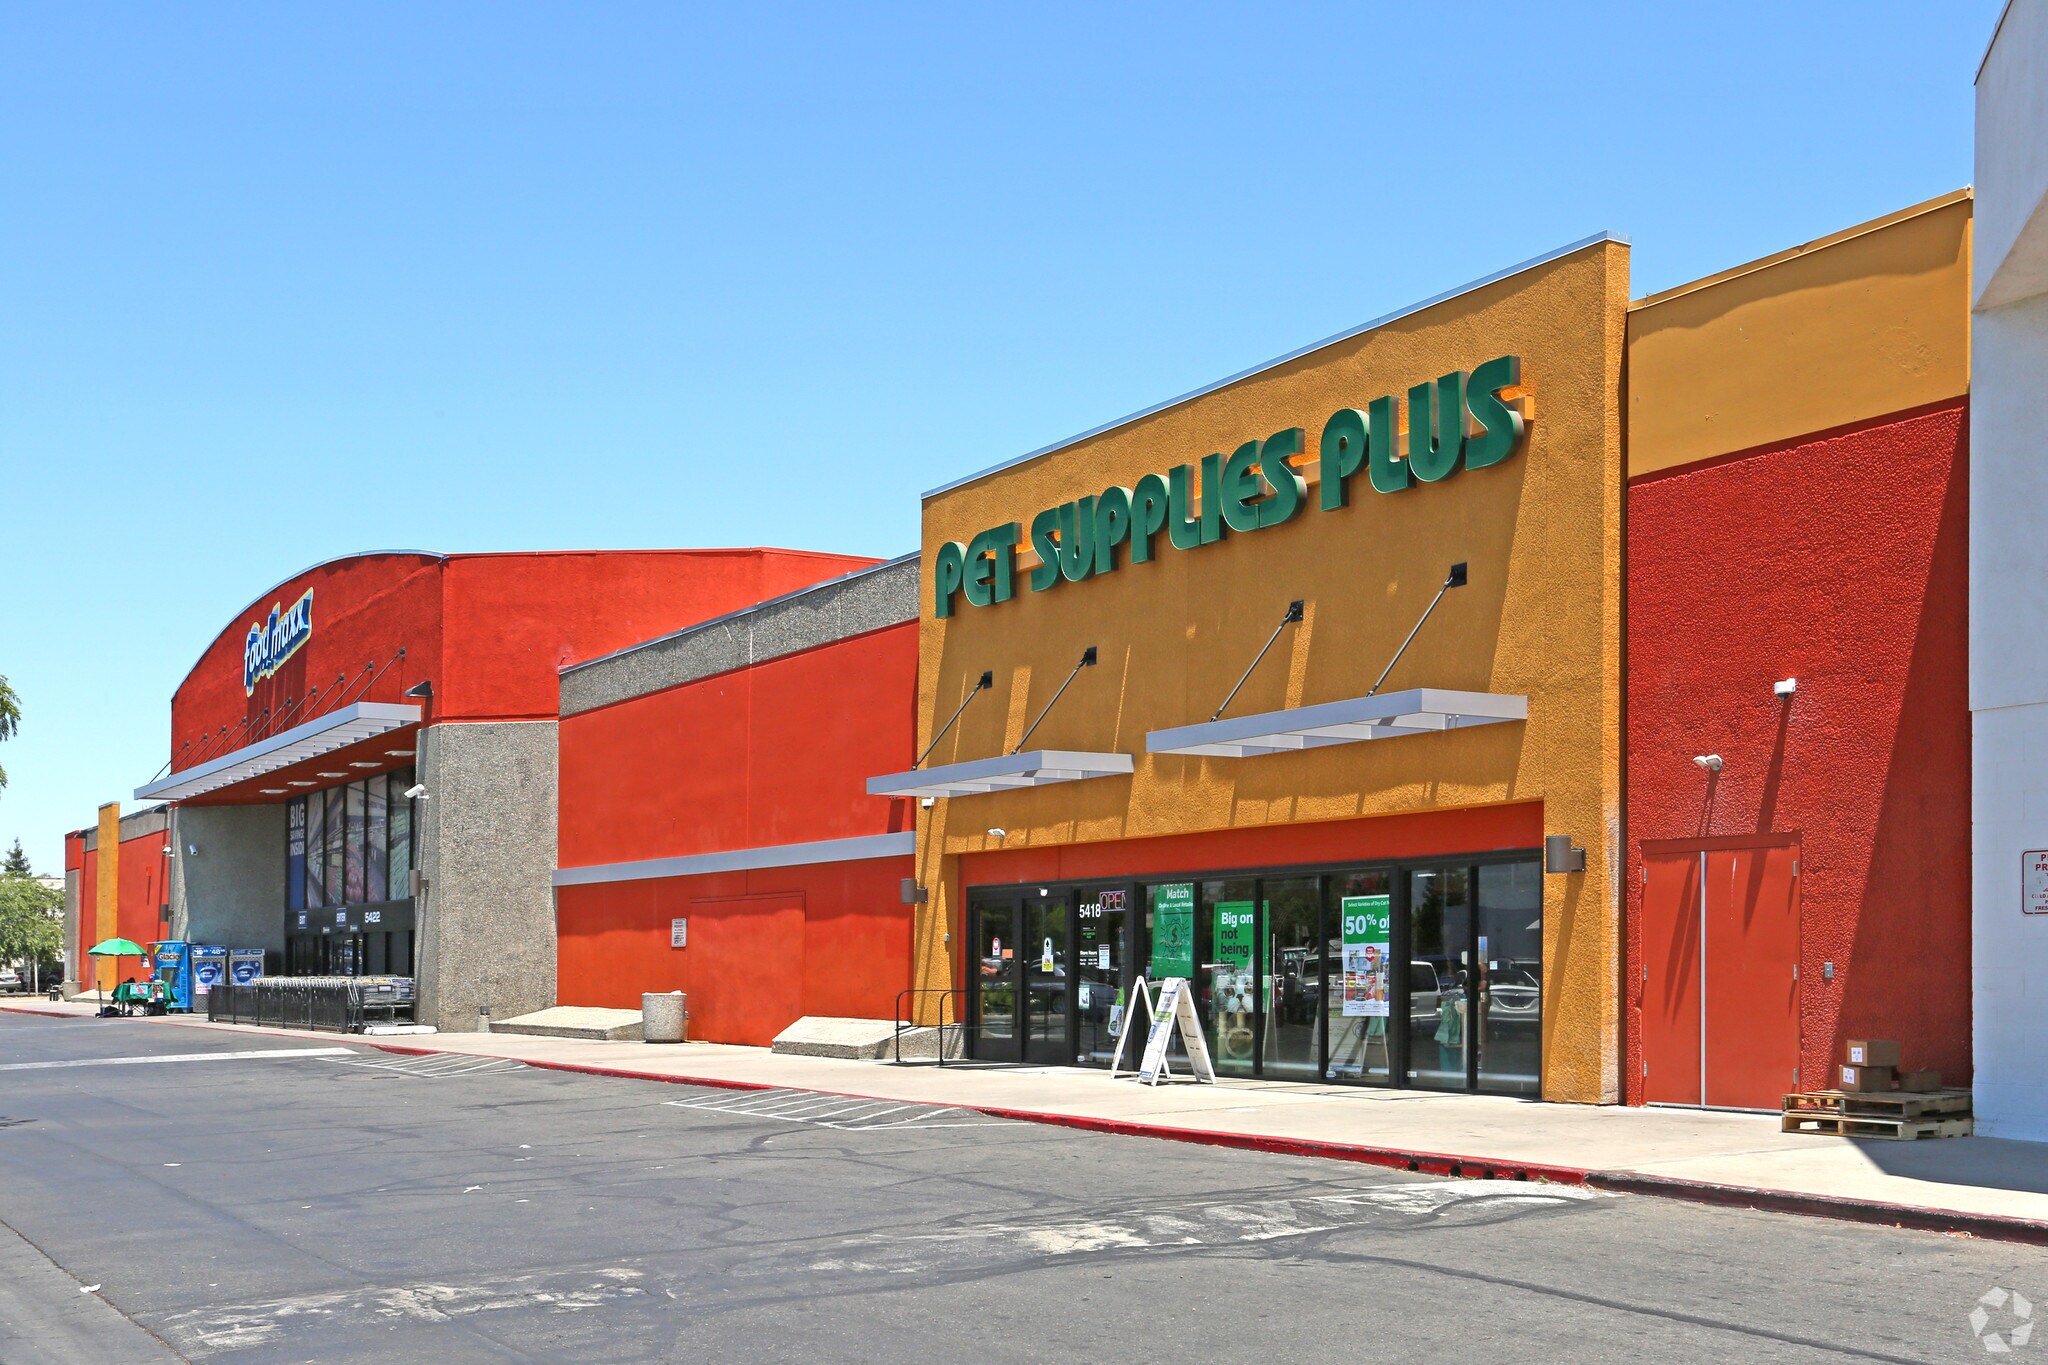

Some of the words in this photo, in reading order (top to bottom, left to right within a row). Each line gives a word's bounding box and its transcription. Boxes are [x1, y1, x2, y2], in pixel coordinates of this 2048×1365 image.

[935, 522, 1021, 618] PET
[1030, 427, 1307, 592] SUPPLIES
[1320, 355, 1525, 512] PLUS
[290, 803, 304, 828] BIG
[1166, 888, 1189, 899] Match
[365, 911, 380, 923] 5422
[1080, 904, 1101, 918] 5418
[1221, 912, 1237, 927] Big
[1240, 913, 1253, 924] on
[1221, 928, 1238, 940] not
[1220, 942, 1249, 958] being
